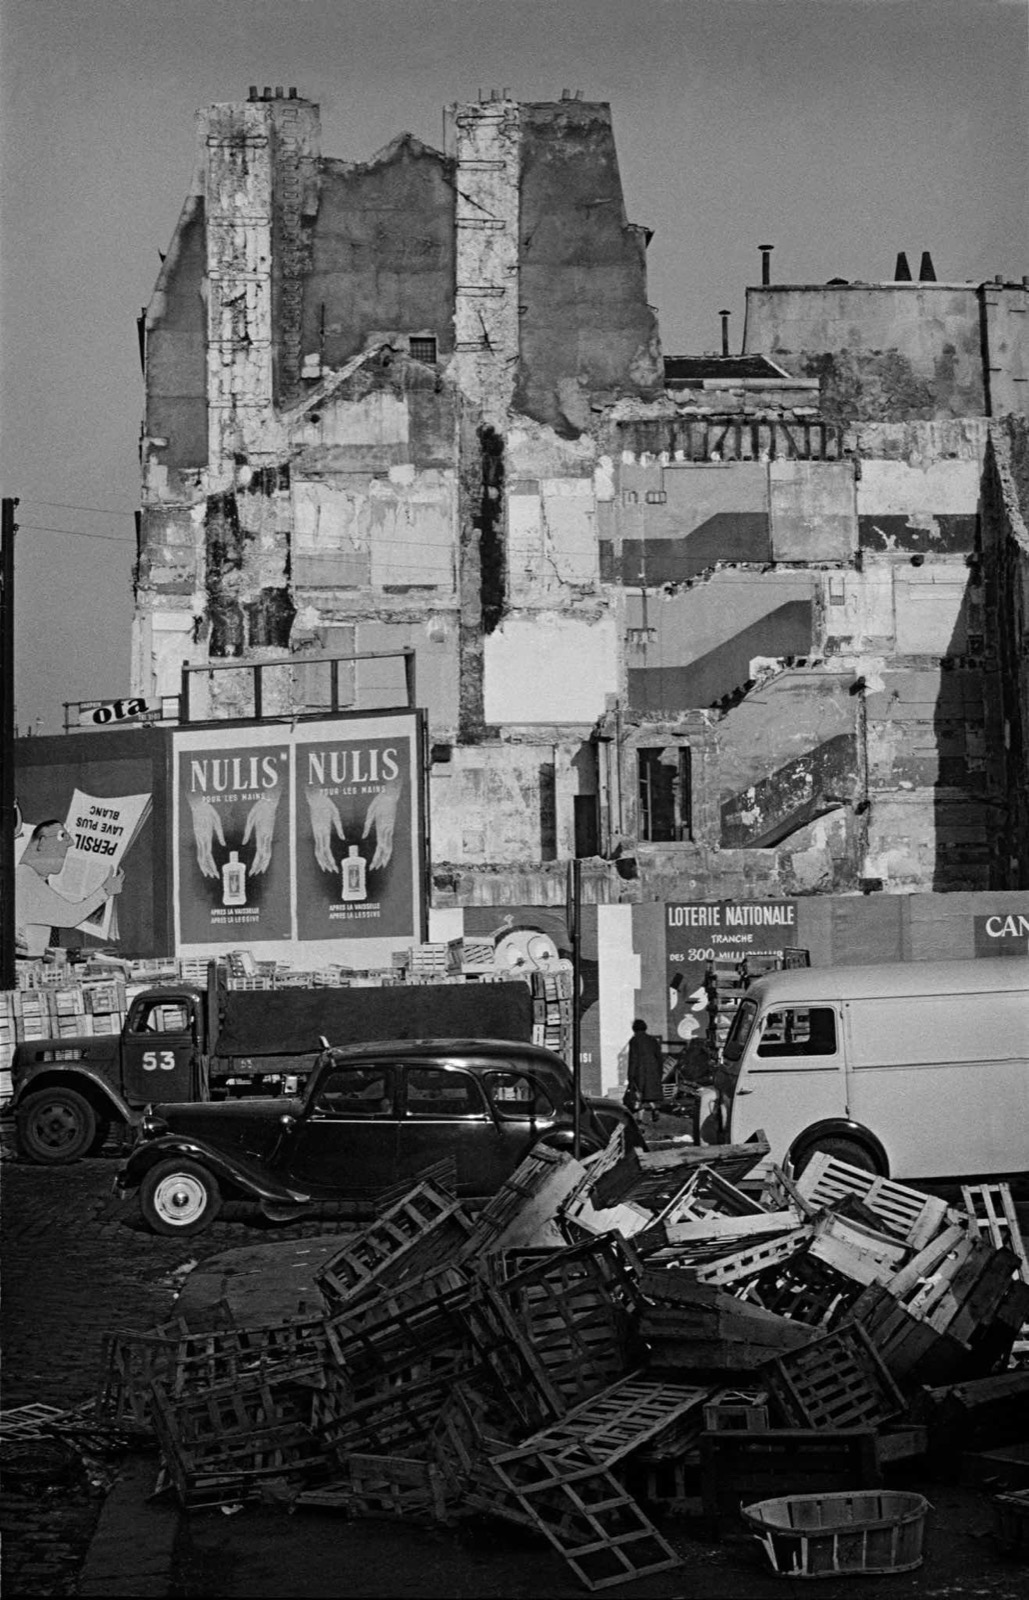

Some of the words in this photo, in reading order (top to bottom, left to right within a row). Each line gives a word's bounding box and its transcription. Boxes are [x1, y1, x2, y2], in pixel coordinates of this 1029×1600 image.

[93, 698, 149, 724] ota
[190, 756, 278, 792] NULIS
[308, 748, 399, 785] NULIS
[343, 787, 357, 795] LES
[361, 785, 386, 794] MAINS
[224, 794, 238, 802] LES
[89, 805, 120, 820] BLANC
[75, 817, 99, 831] PLUS
[101, 822, 124, 836] LAVE
[75, 833, 118, 856] PERSIL
[668, 906, 720, 926] LOTERIE
[726, 905, 795, 925] NATIONALE
[711, 934, 753, 943] TRANCHE
[669, 953, 685, 961] DES
[688, 948, 715, 961] 300
[142, 1051, 175, 1071] 53
